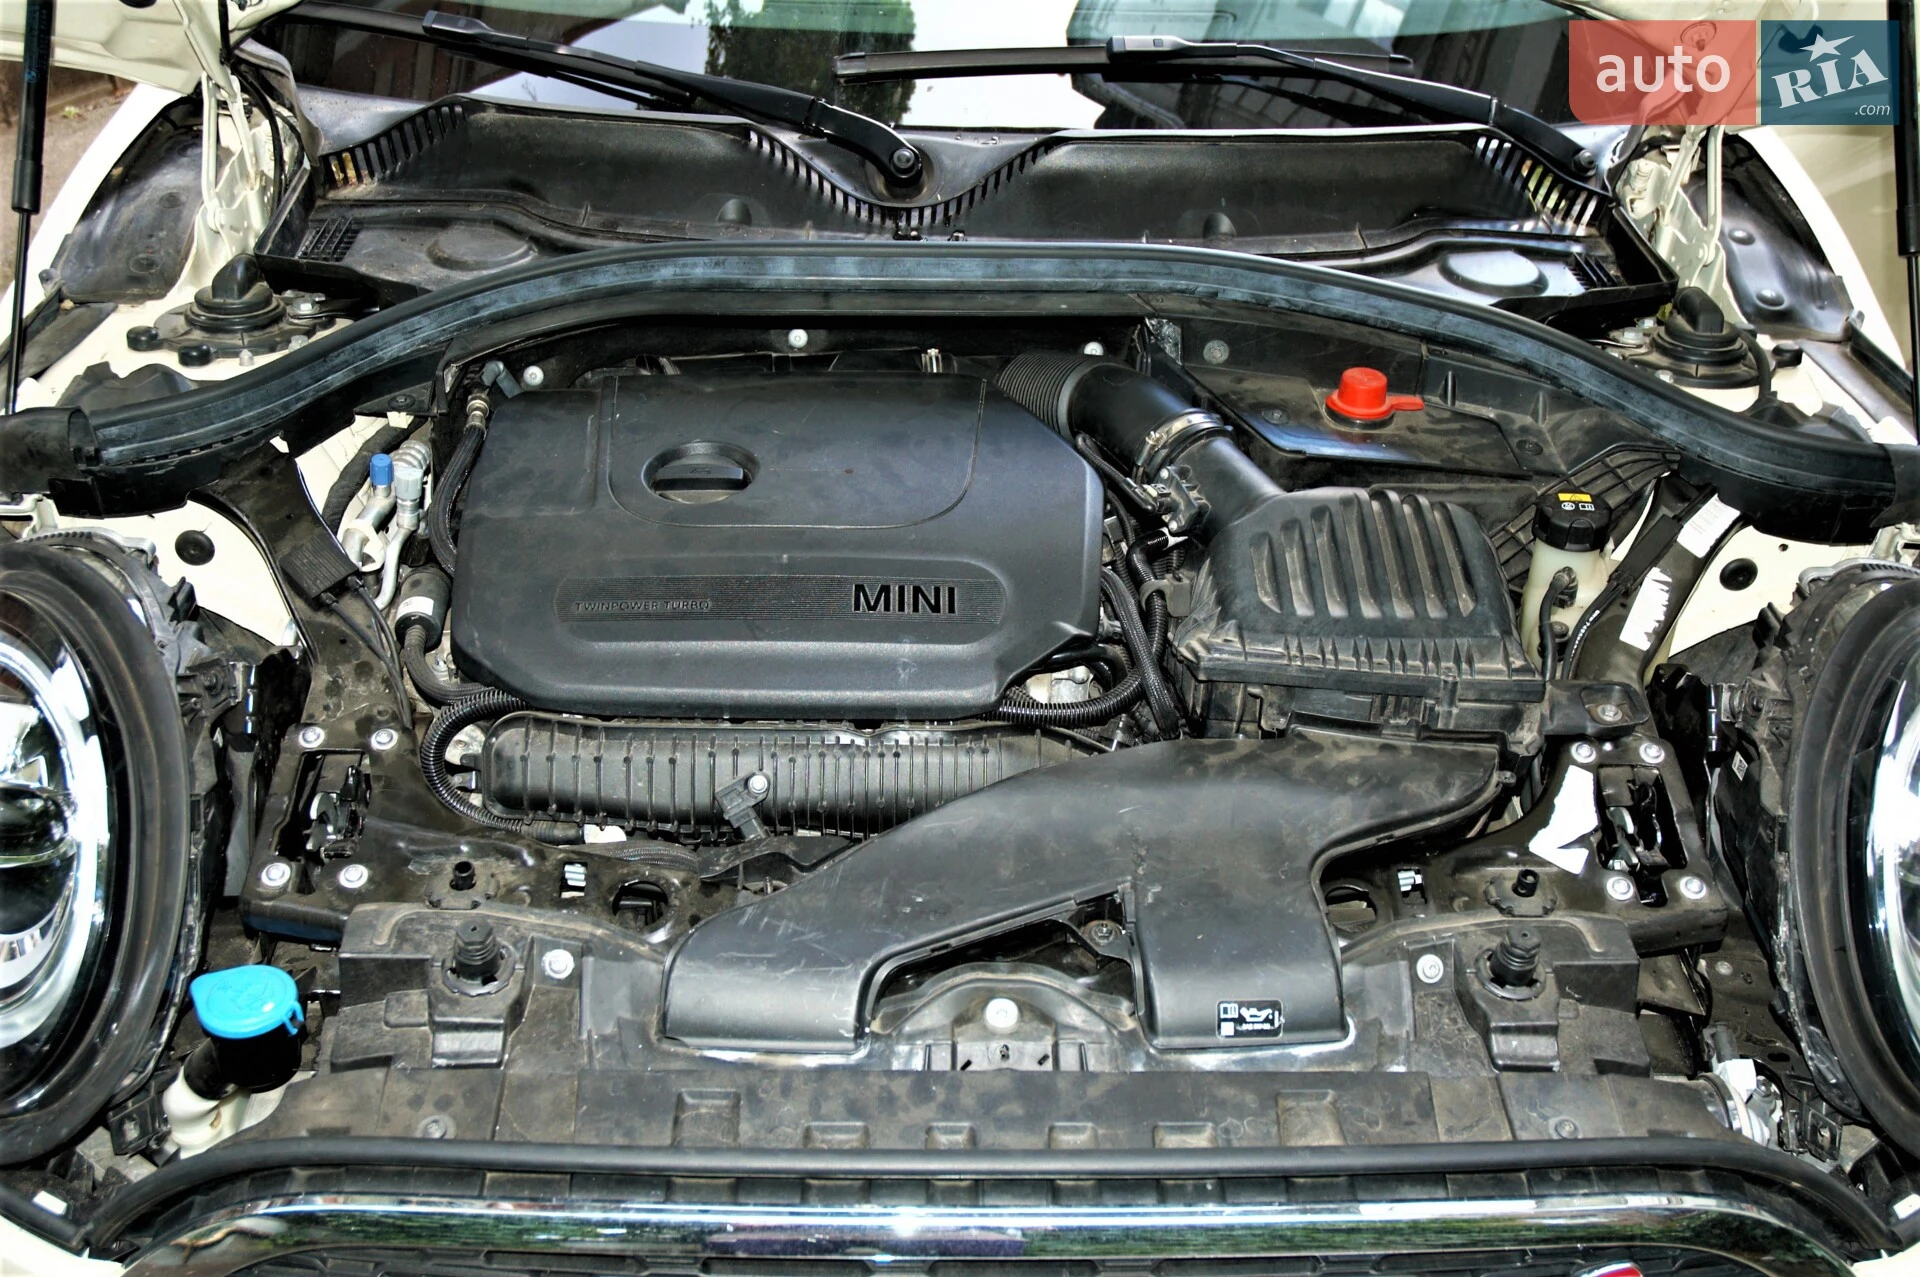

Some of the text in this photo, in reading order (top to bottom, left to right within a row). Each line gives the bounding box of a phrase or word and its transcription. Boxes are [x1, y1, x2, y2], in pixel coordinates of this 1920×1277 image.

[575, 600, 710, 611] TWINPOWER TURBO
[852, 583, 958, 615] MINI
